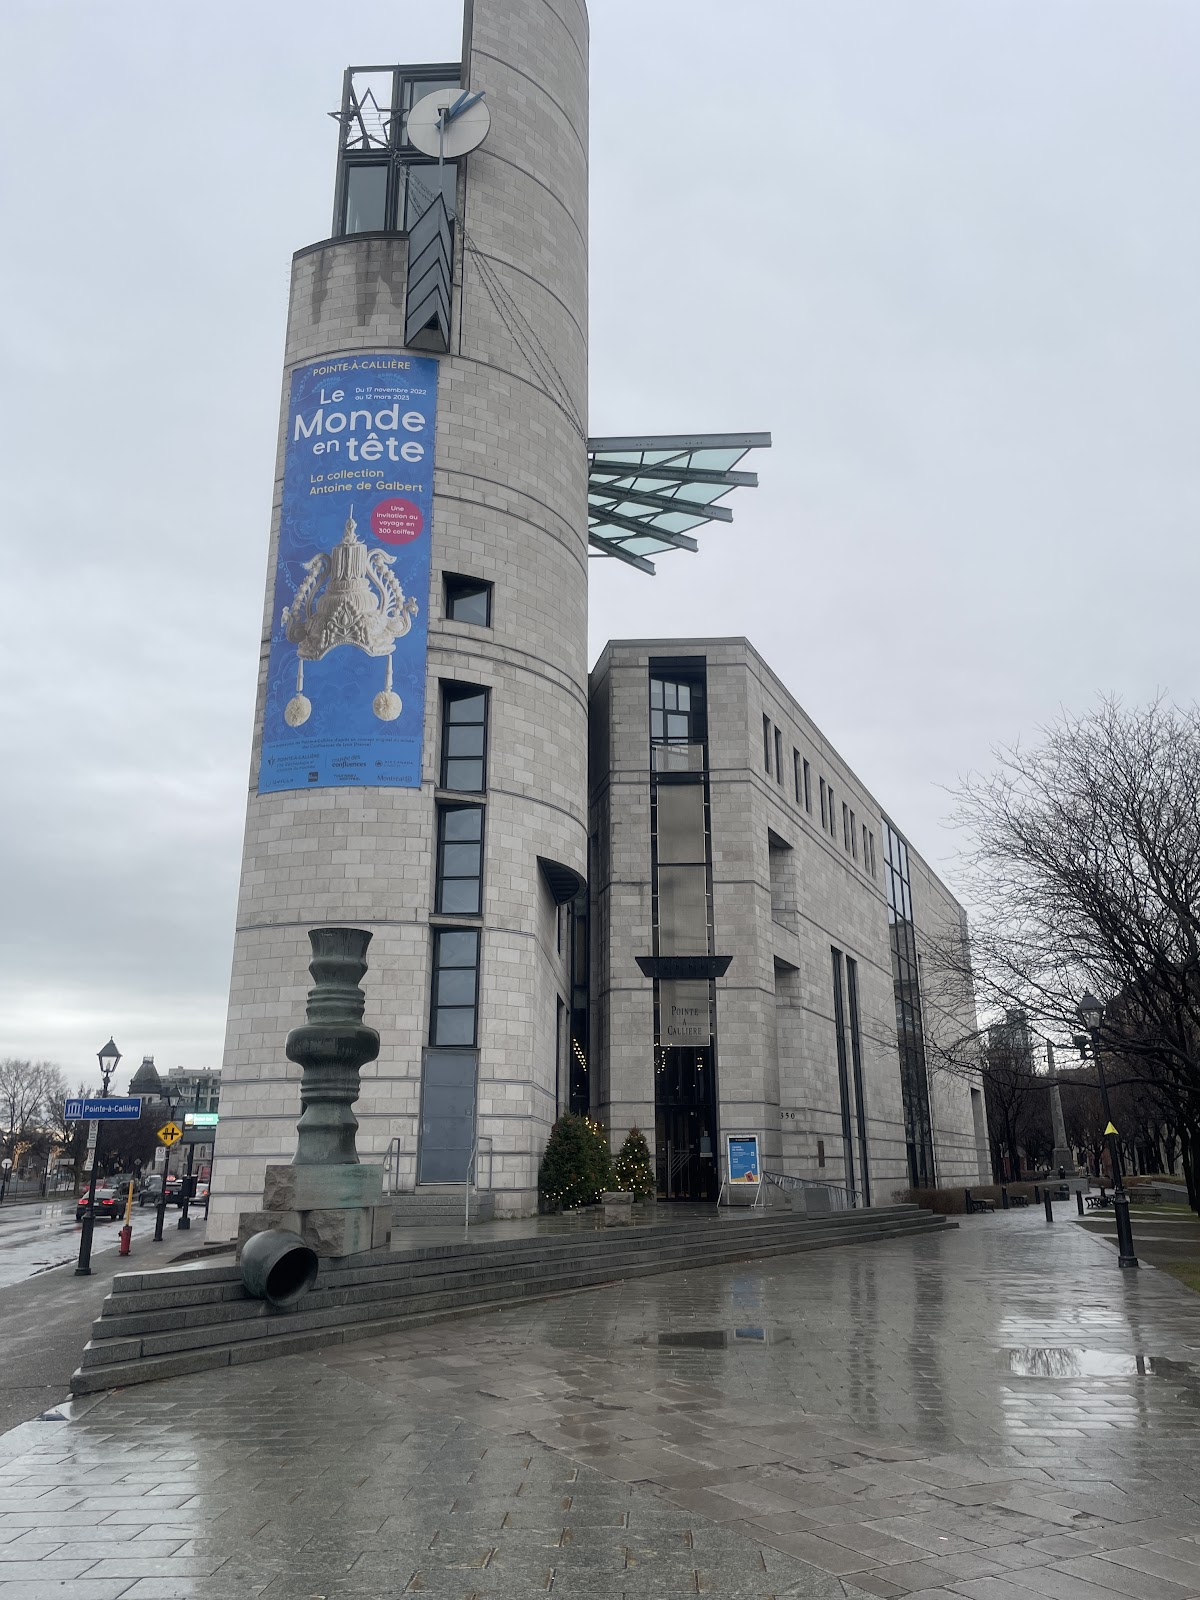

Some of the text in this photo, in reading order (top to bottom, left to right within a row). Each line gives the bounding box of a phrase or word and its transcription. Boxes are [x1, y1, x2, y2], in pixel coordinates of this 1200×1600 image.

[313, 360, 411, 376] POINTE-À-CALLIÈRE
[320, 388, 345, 405] Le
[294, 404, 426, 441] Monde
[313, 432, 424, 462] en tête
[310, 469, 384, 483] La collection
[310, 481, 423, 495] Antoine de Galbert
[672, 1006, 698, 1016] POINTE
